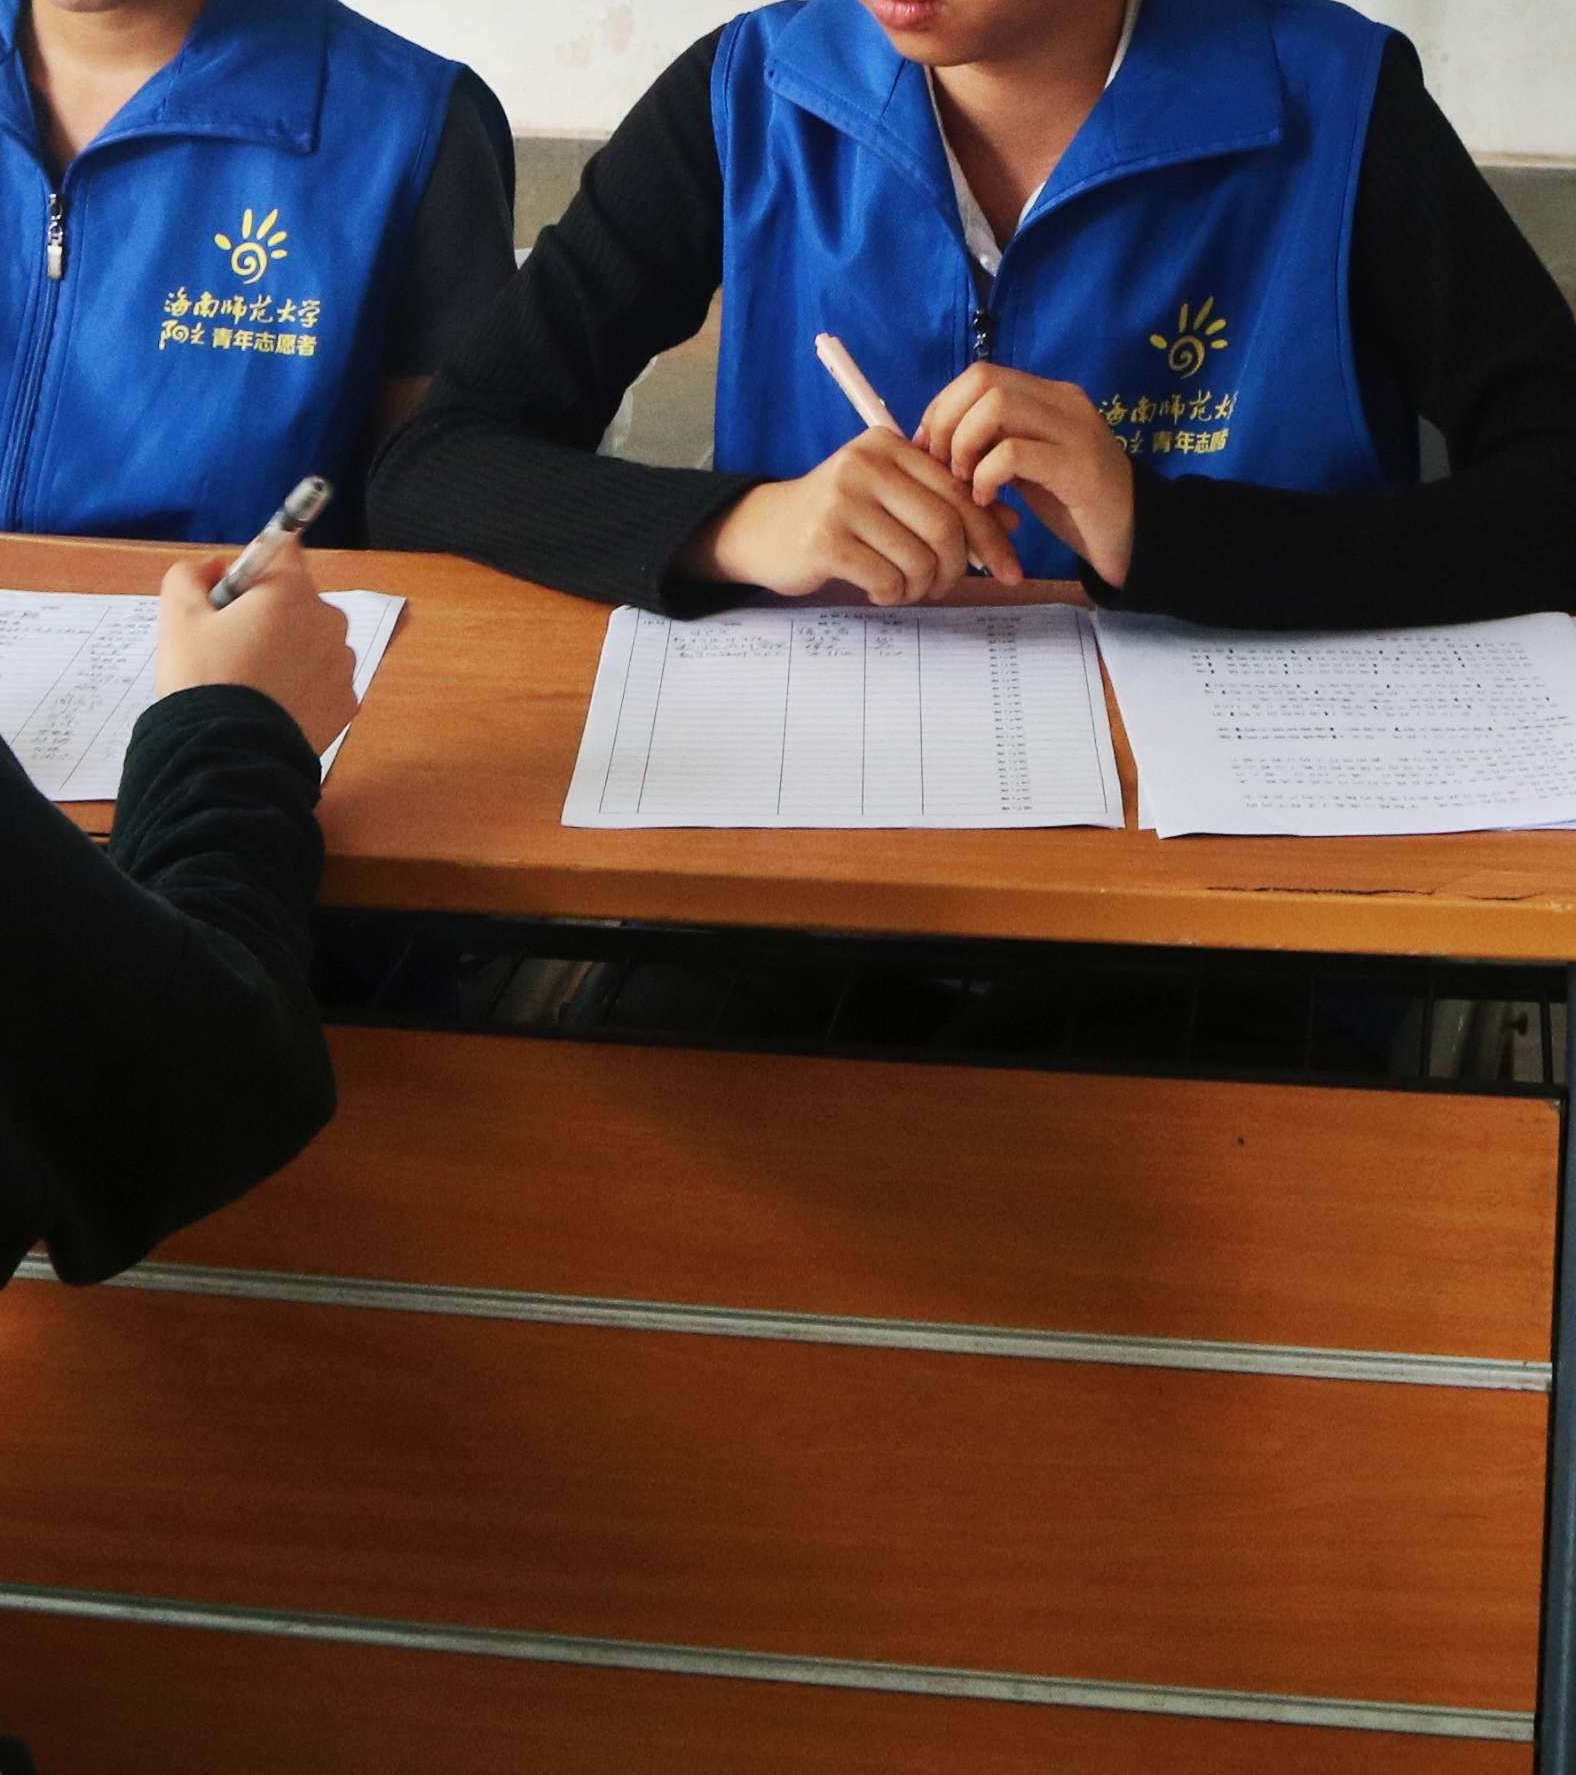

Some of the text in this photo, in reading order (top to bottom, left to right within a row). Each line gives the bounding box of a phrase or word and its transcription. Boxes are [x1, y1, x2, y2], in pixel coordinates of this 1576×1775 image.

[163, 287, 321, 329] 海南师范大学
[212, 327, 318, 357] 青年志愿者
